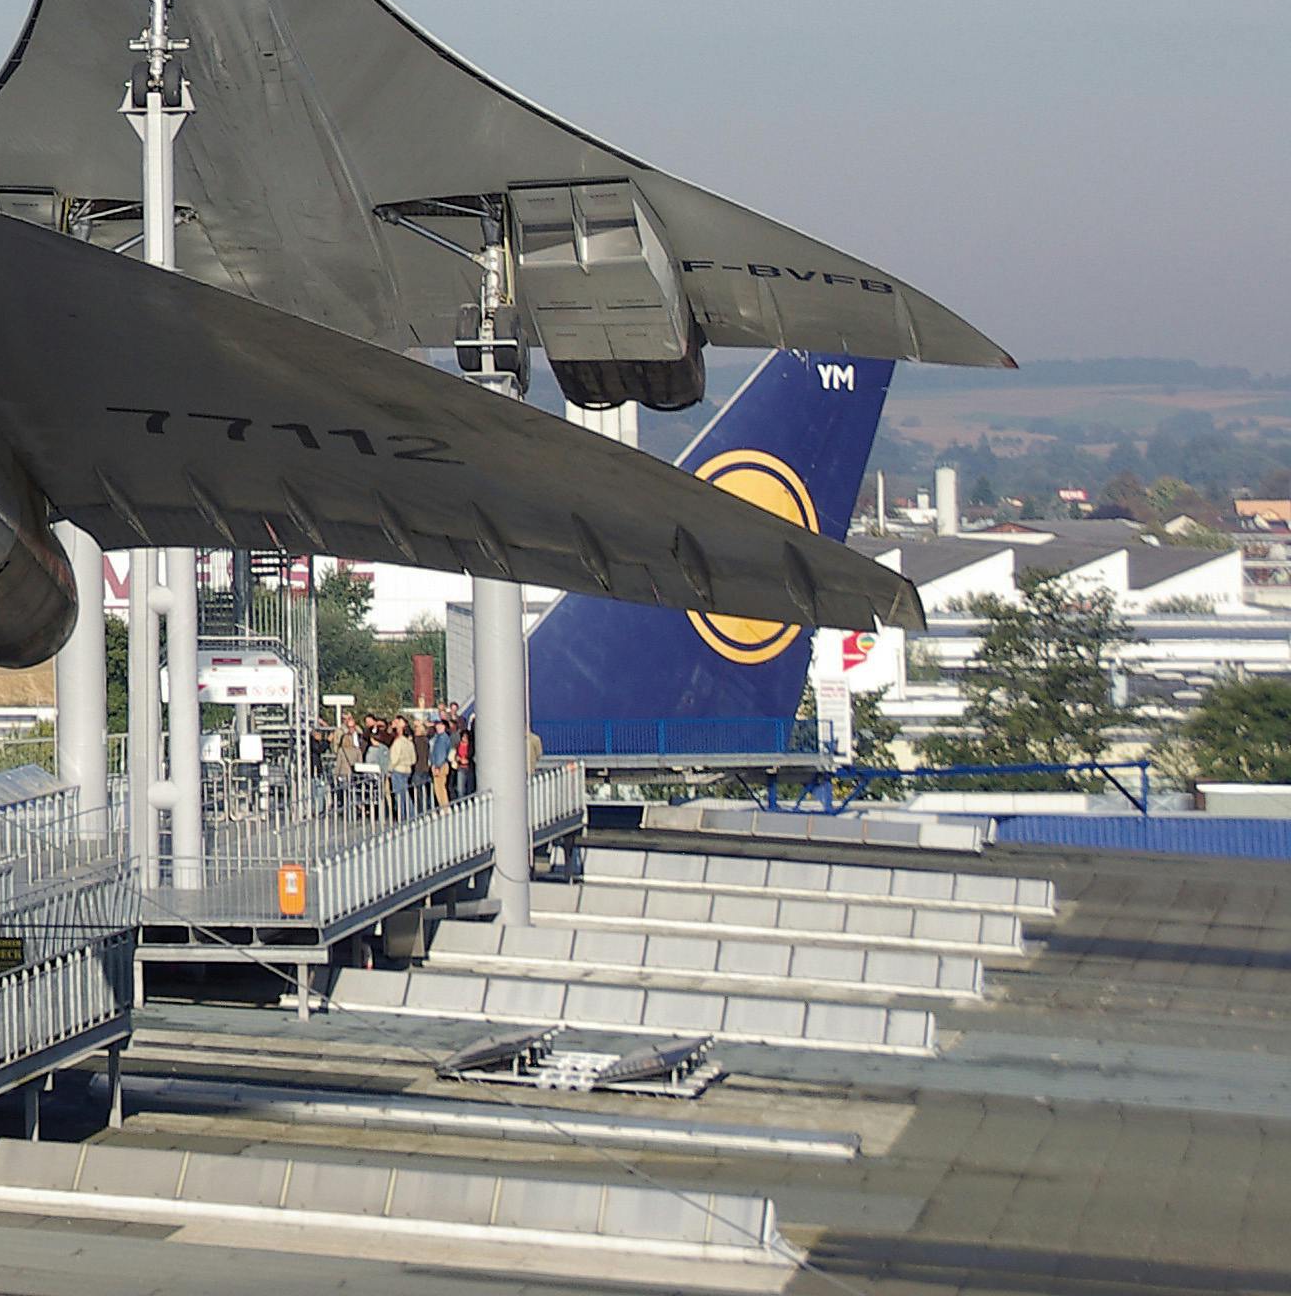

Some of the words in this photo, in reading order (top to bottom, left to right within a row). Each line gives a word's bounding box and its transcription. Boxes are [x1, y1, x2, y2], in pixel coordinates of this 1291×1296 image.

[681, 260, 894, 294] F-BVFB
[817, 364, 855, 392] YM
[106, 406, 466, 466] 77112
